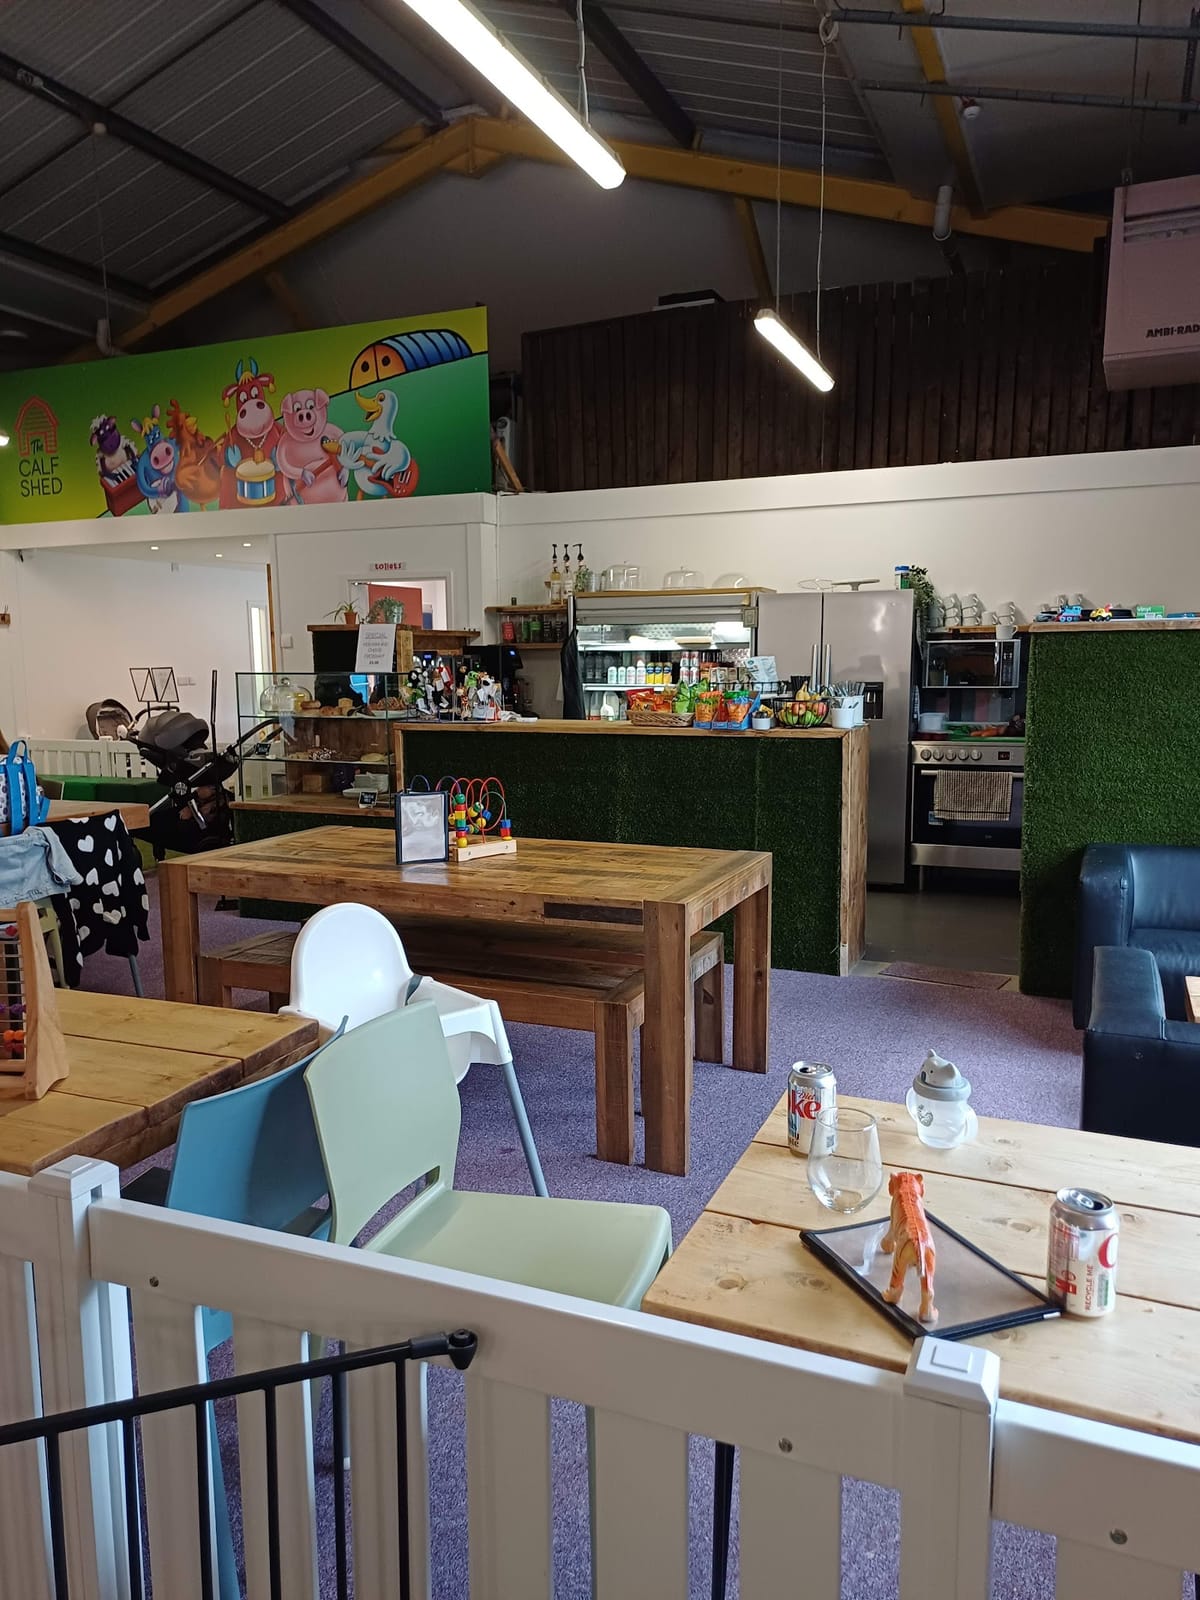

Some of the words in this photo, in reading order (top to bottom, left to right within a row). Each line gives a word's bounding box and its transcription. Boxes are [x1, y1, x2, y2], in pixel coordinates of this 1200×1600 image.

[18, 456, 59, 477] CALF
[20, 477, 63, 497] SHED
[1086, 1263, 1094, 1276] ME
[1084, 1278, 1094, 1311] RECYCLE
